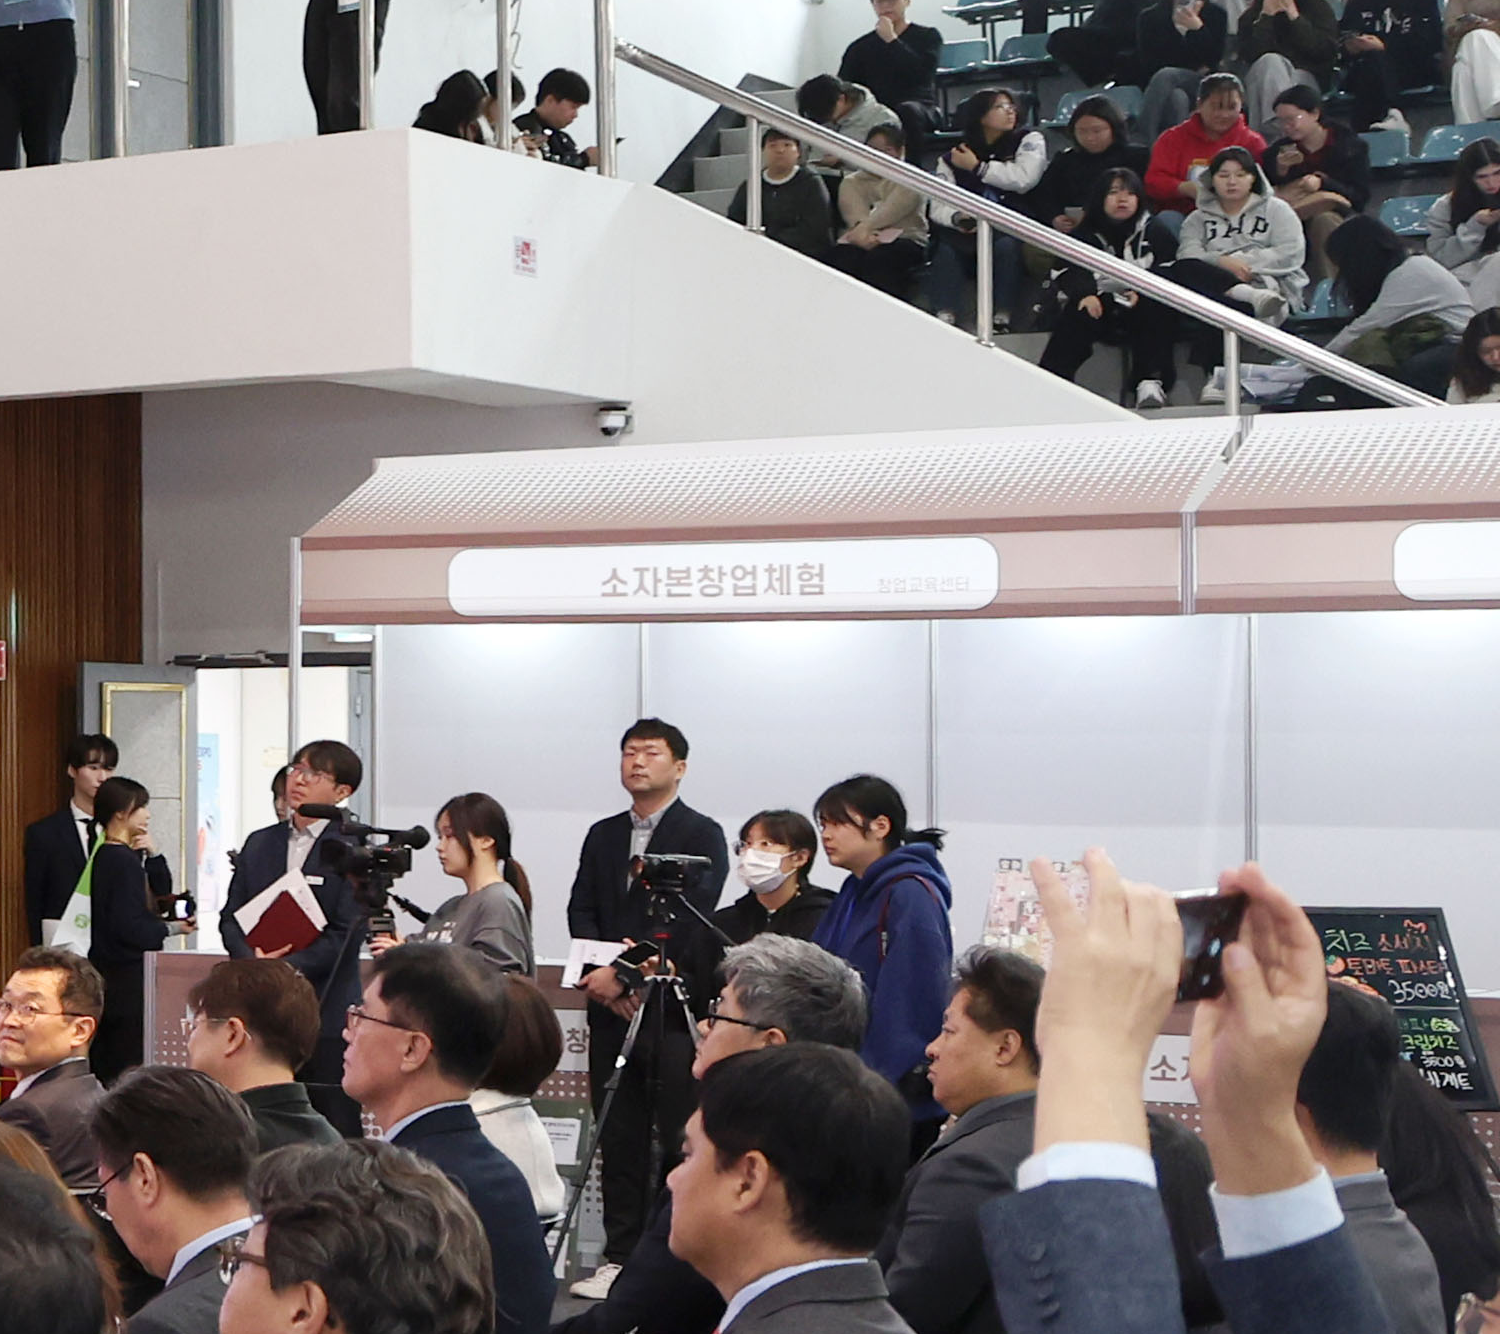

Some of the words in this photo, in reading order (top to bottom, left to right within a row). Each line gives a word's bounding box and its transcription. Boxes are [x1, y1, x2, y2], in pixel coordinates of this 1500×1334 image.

[600, 563, 826, 598] 소자본창업체험
[877, 575, 971, 593] 창업교육센터
[1325, 929, 1373, 952] 치즈
